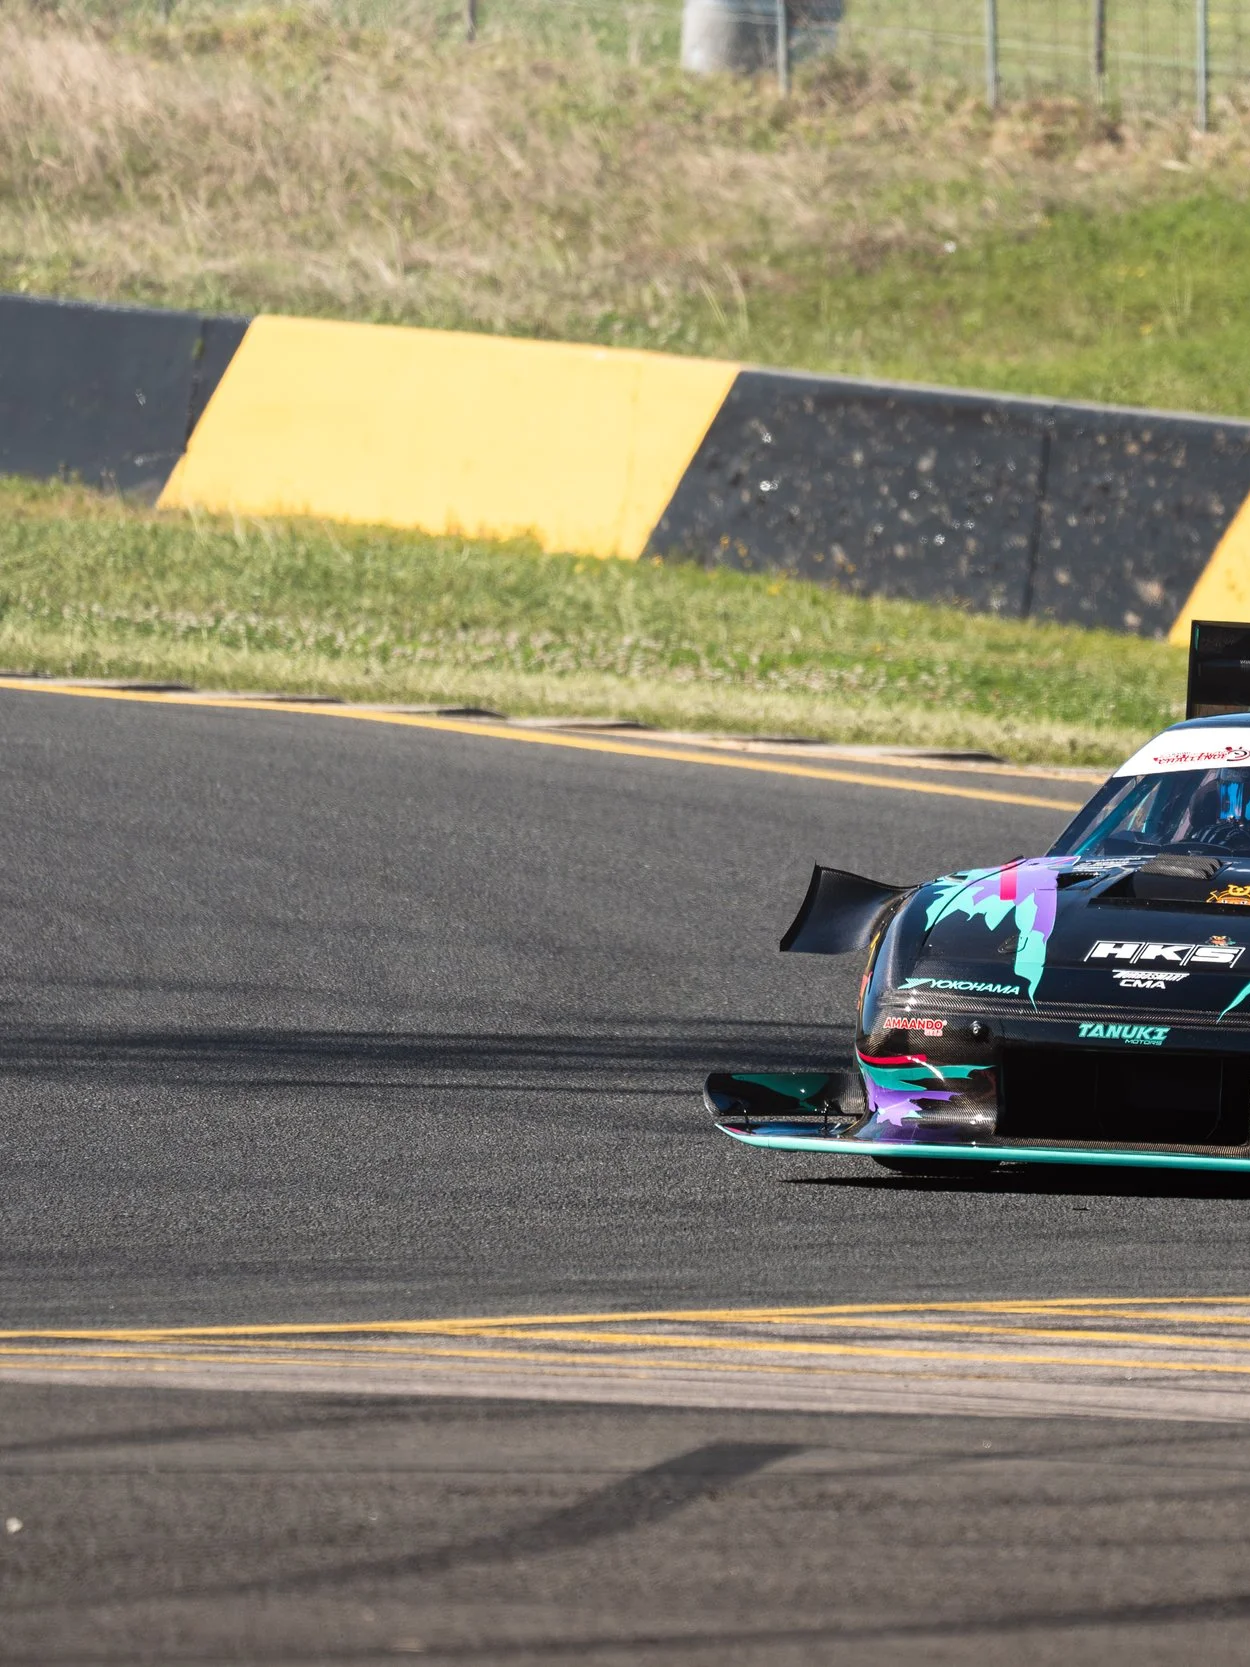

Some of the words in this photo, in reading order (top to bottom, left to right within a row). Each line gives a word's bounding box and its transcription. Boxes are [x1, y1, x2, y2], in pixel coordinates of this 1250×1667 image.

[1084, 940, 1246, 968] HKS
[930, 979, 1020, 995] YOKOHAMA
[1119, 979, 1166, 989] CMA
[883, 1017, 944, 1030] AMAANDO
[1079, 1023, 1171, 1040] TANUKI
